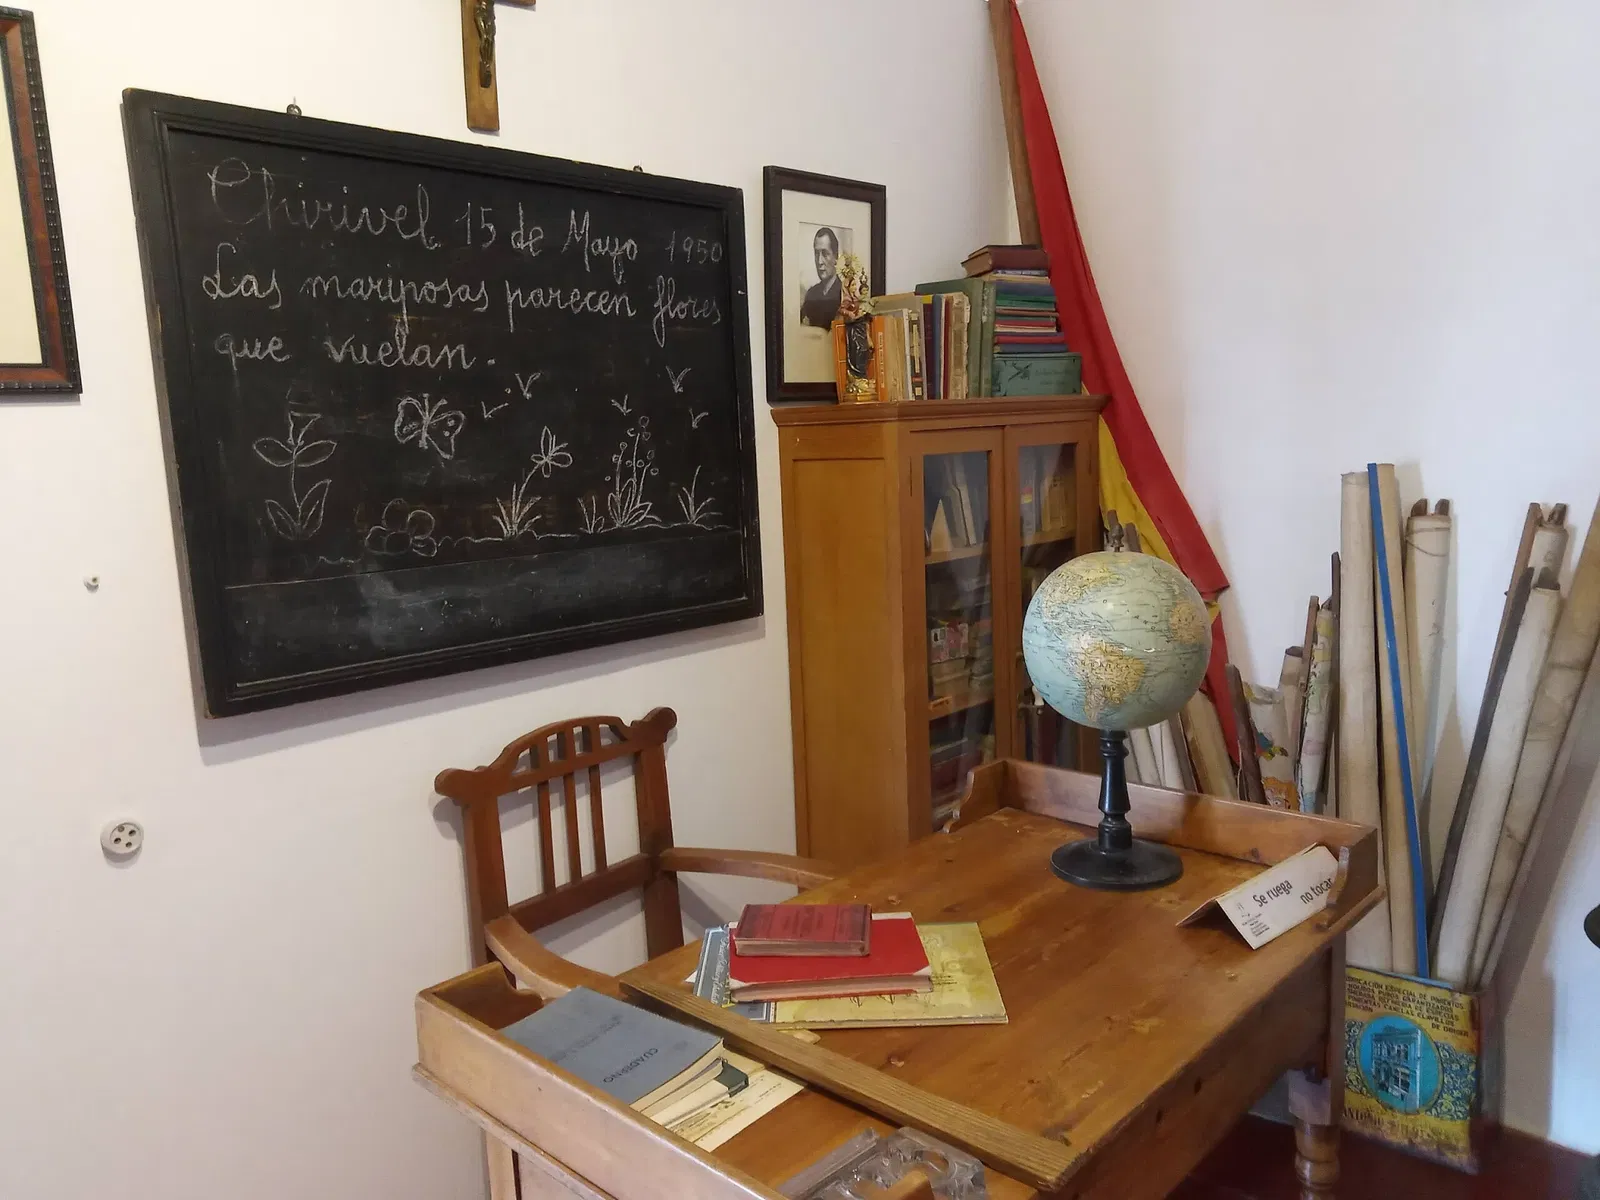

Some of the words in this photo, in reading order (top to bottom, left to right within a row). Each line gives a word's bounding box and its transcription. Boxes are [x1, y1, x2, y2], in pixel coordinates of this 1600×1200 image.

[207, 157, 441, 250] Chirivel
[456, 202, 497, 248] 15
[511, 202, 544, 257] de
[562, 209, 638, 284] Mayo
[665, 231, 723, 264] 1950
[202, 242, 282, 310] Las
[300, 263, 489, 334] mariposas
[505, 280, 636, 333] parecen
[652, 275, 721, 348] flores
[214, 333, 290, 378] que
[1252, 894, 1268, 908] Se
[1266, 879, 1293, 900] ruega
[1299, 891, 1314, 905] no
[1311, 878, 1333, 897] tocar
[1431, 1022, 1441, 1031] DE
